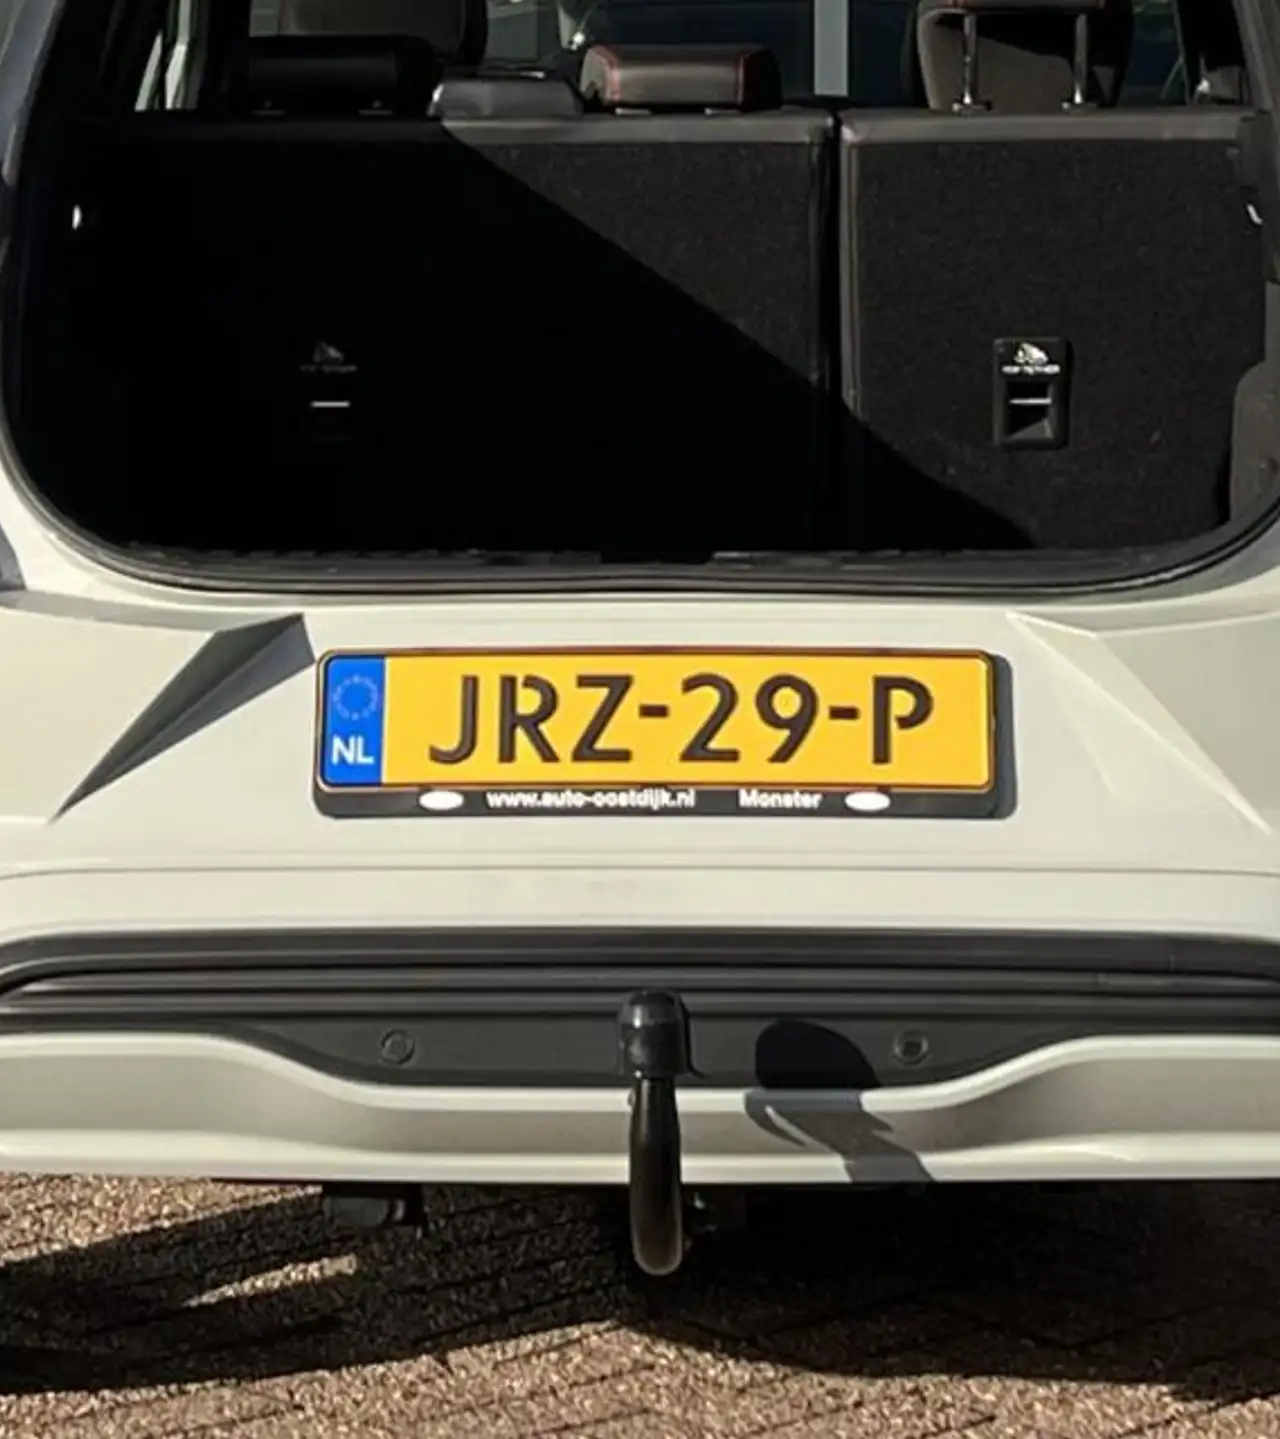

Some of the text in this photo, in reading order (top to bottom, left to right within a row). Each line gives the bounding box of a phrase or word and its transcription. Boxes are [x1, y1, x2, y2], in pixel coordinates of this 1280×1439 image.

[332, 674, 935, 765] NL JRZ-29-P
[739, 789, 822, 809] Monster
